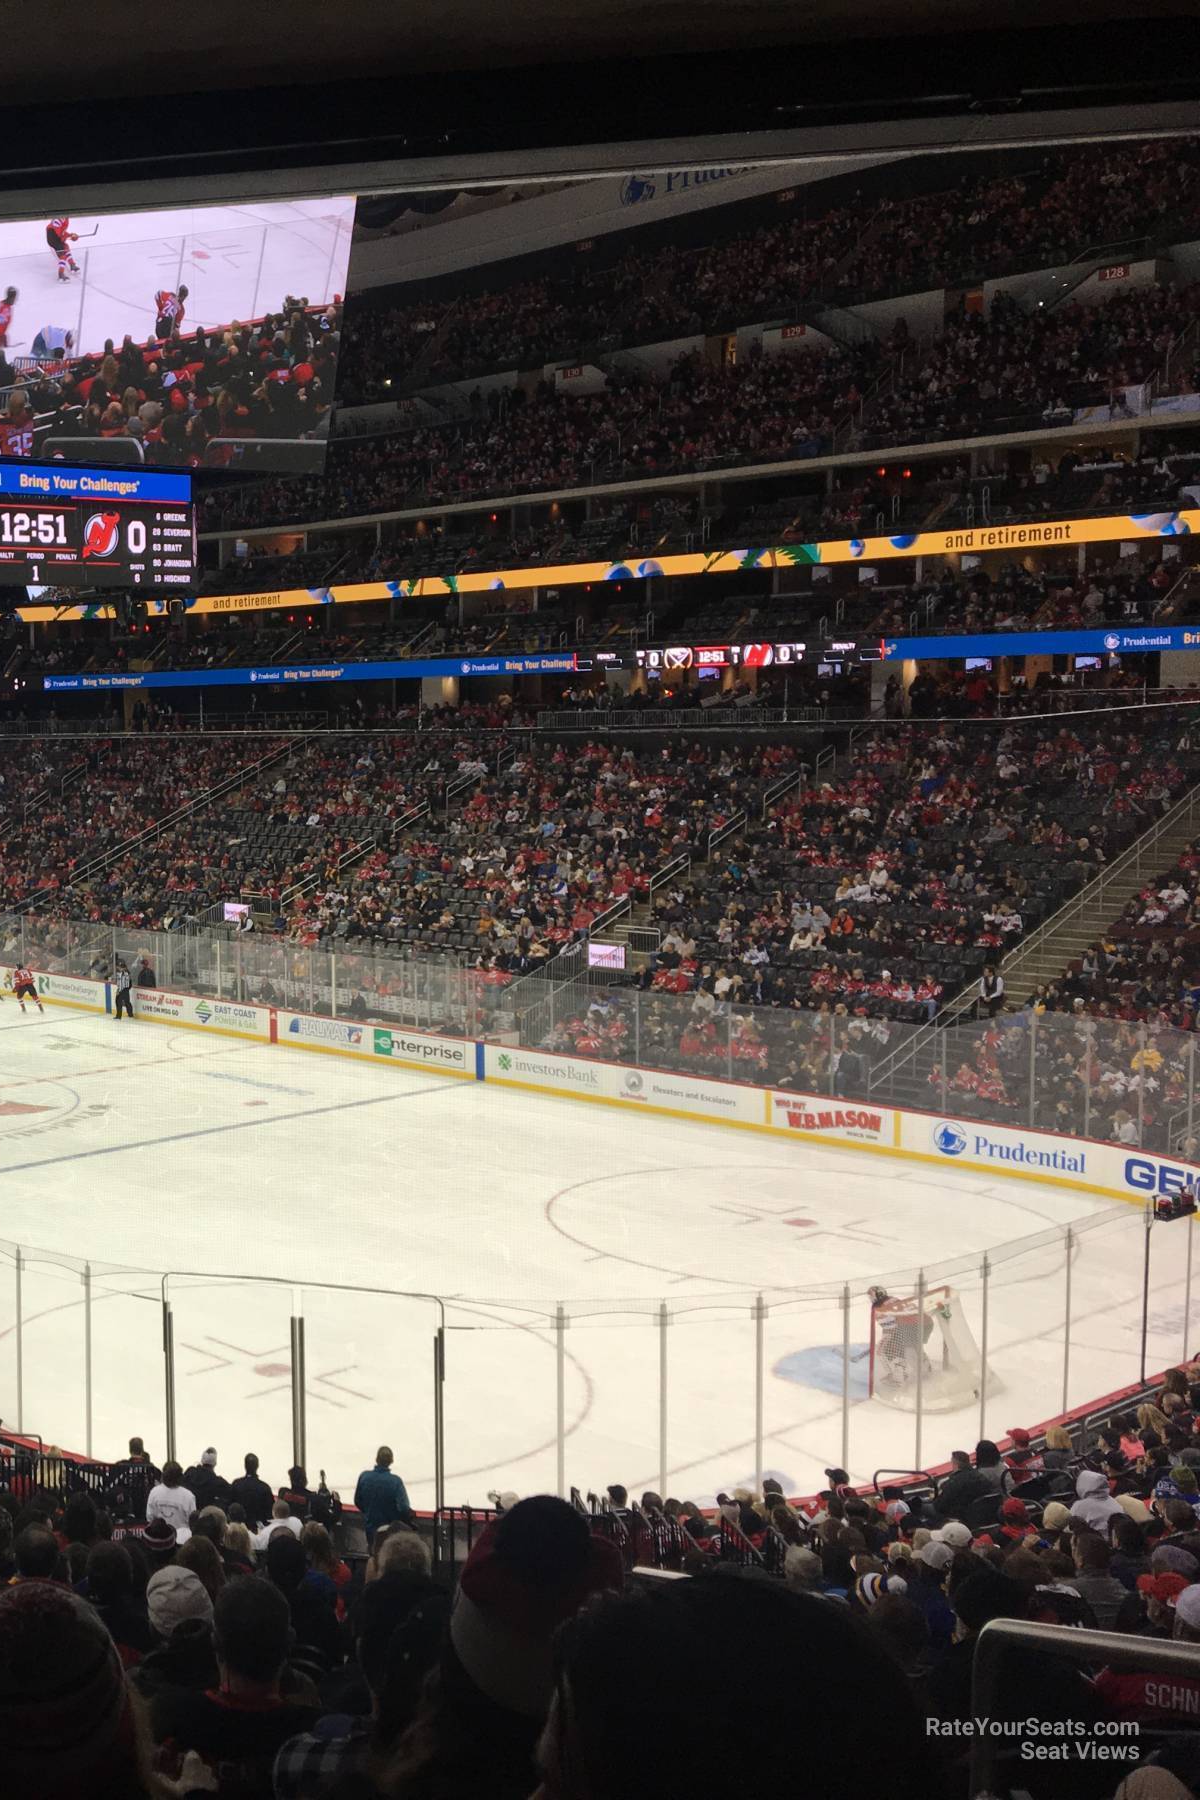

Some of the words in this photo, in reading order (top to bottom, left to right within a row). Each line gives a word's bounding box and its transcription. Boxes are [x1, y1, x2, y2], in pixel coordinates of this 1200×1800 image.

[1104, 266, 1125, 279] 128
[785, 326, 802, 338] 129
[565, 367, 580, 379] 130
[19, 474, 50, 491] Bring
[52, 475, 78, 489] Your
[163, 513, 186, 522] GREENE
[1, 512, 67, 544] 12:51
[163, 528, 191, 537] SEVERSON
[127, 520, 147, 554] 0
[945, 531, 973, 549] and
[981, 524, 1072, 546] retirement
[163, 544, 182, 552] BRATT
[26, 552, 45, 560] PERIOD
[55, 553, 78, 561] PENALTY
[130, 563, 145, 571] SHOTS
[32, 565, 40, 582] 1
[134, 573, 141, 583] 6
[213, 598, 230, 609] and
[235, 594, 281, 608] retirement
[1123, 635, 1171, 647] Prudential
[650, 652, 659, 666] 0
[699, 651, 725, 663] 12:51
[780, 647, 790, 661] 0
[471, 663, 499, 671] Prudential
[505, 660, 524, 671] Bring
[524, 660, 540, 669] Your
[283, 671, 298, 680] Bring
[82, 678, 97, 687] Bring
[98, 678, 111, 686] Your
[214, 1005, 232, 1017] EAST
[232, 1007, 257, 1020] COAST
[299, 1018, 352, 1042] HALMAR
[375, 1035, 464, 1061] enterprise
[686, 1090, 698, 1100] and
[973, 1134, 1086, 1174] Prudential
